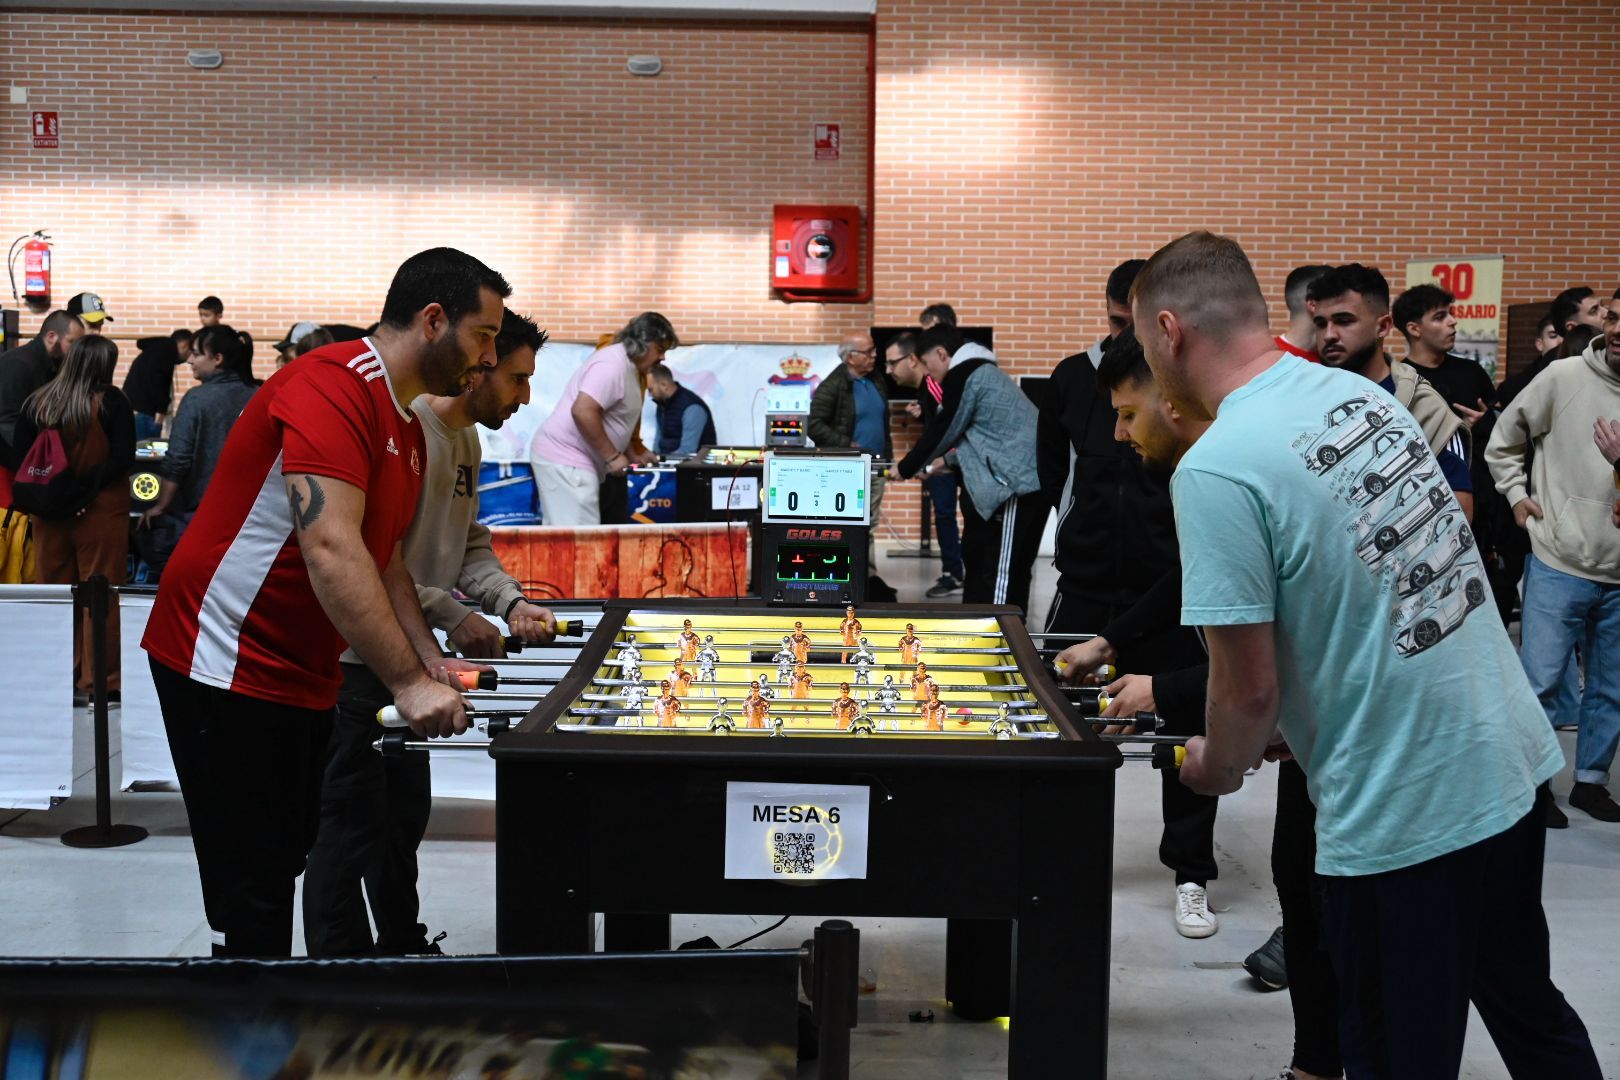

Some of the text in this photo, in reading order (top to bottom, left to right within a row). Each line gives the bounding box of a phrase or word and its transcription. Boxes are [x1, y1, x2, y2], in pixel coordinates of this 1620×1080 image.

[1431, 263, 1474, 300] 30
[788, 491, 798, 511] 0
[835, 492, 846, 512] 0
[786, 528, 843, 540] GOLES
[752, 804, 841, 824] MESA 6
